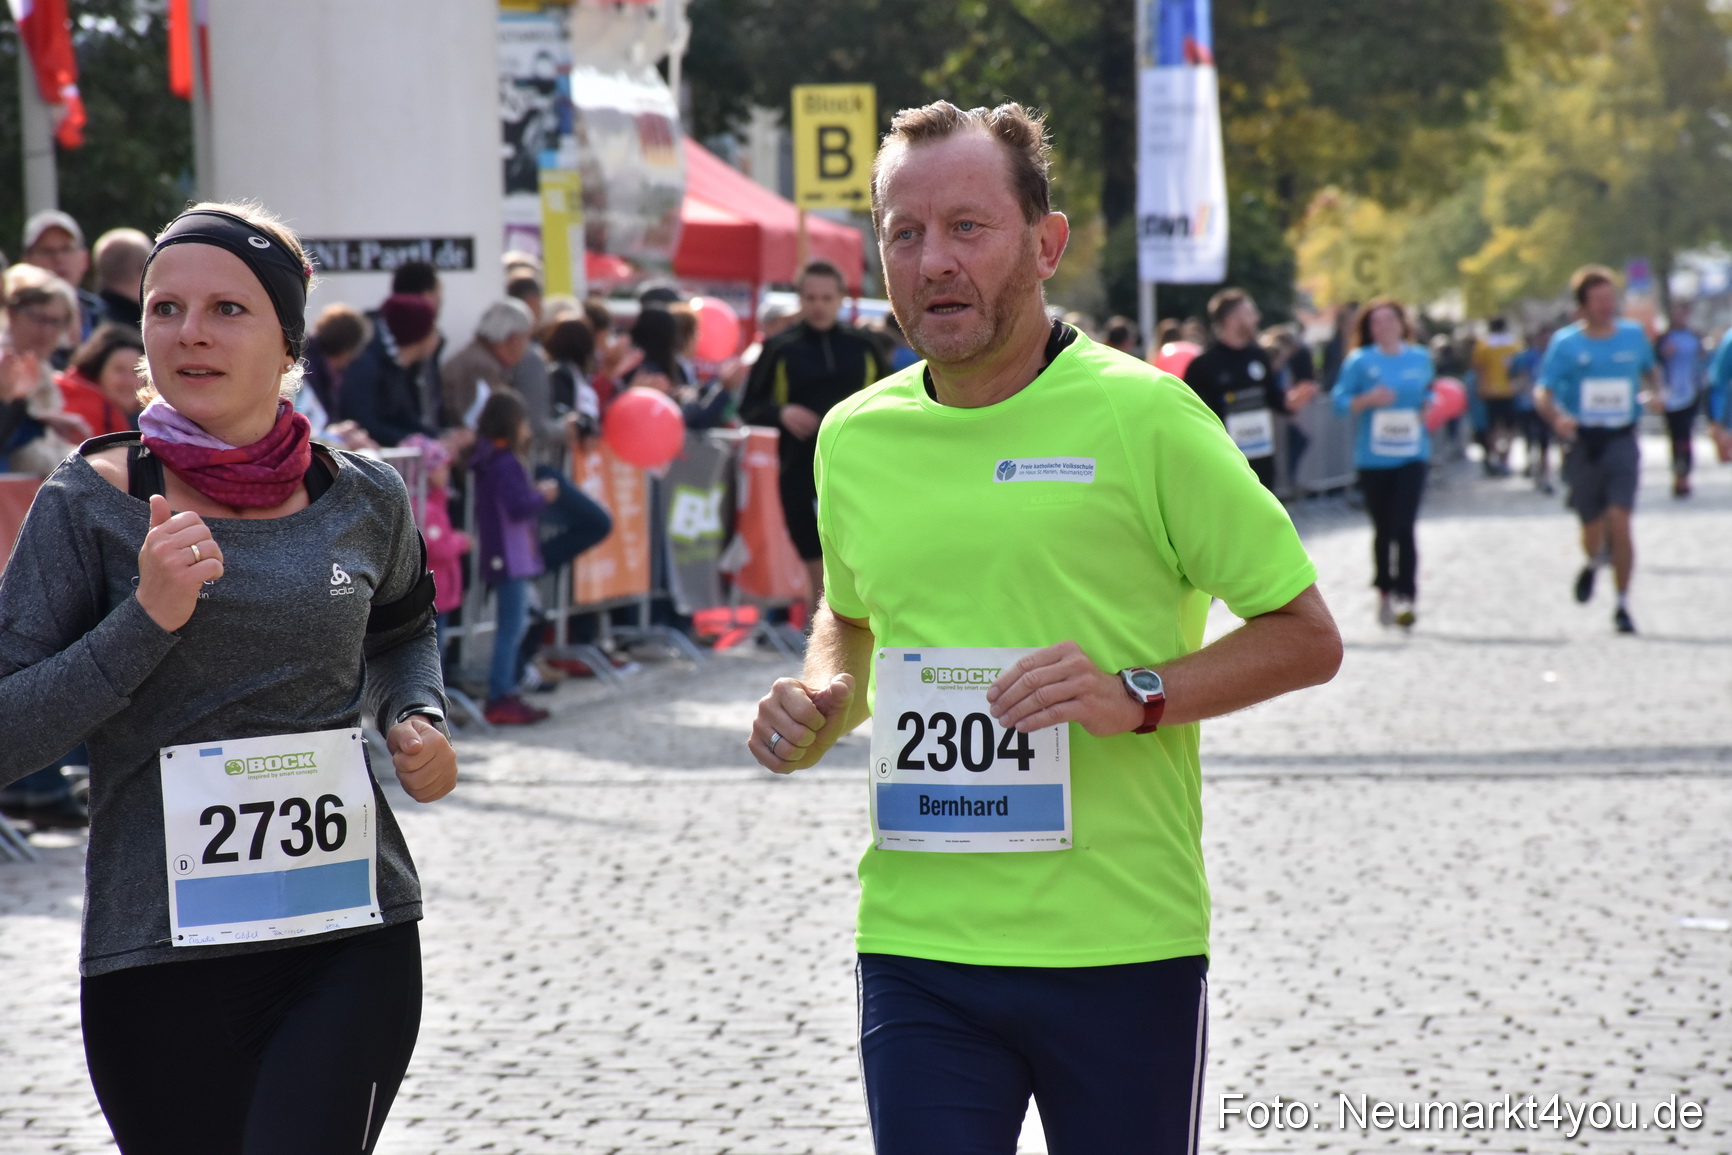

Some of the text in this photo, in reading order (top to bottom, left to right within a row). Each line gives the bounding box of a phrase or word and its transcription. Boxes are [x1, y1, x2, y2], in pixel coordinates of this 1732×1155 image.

[818, 126, 854, 179] B
[937, 668, 1002, 684] BOCK
[896, 711, 1036, 772] 2304
[246, 751, 317, 774] BOCK
[880, 762, 887, 774] C
[919, 795, 1009, 816] Bernhard
[199, 793, 347, 865] 2736
[180, 860, 188, 871] D
